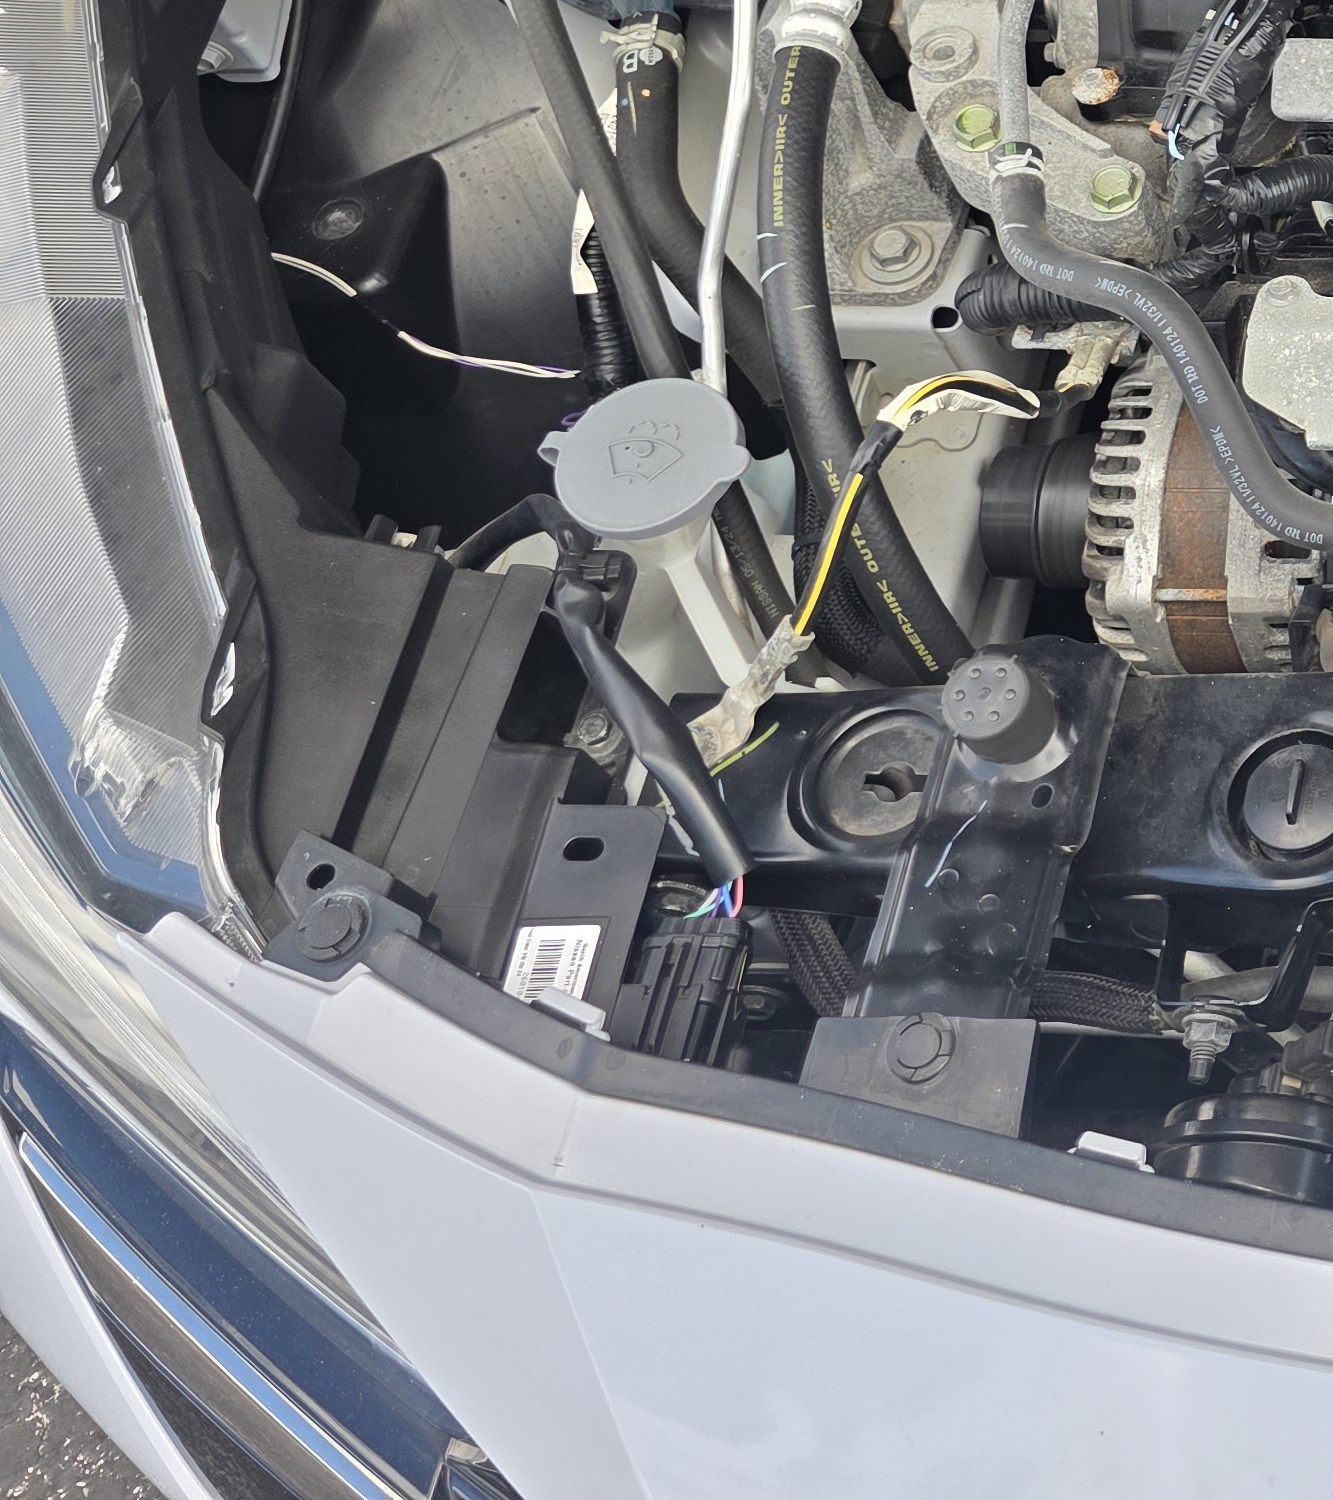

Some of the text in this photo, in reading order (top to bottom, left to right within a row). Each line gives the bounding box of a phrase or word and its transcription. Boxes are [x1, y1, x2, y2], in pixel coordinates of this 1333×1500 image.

[780, 45, 802, 107] OUTER
[1007, 244, 1037, 271] 140124
[1057, 269, 1075, 282] DOT
[1163, 325, 1190, 364] 140124
[1190, 383, 1209, 405] DOT
[1250, 502, 1282, 532] 140124
[850, 521, 880, 575] OUTE
[1302, 531, 1324, 545] DOT
[750, 579, 780, 620] NISSAN
